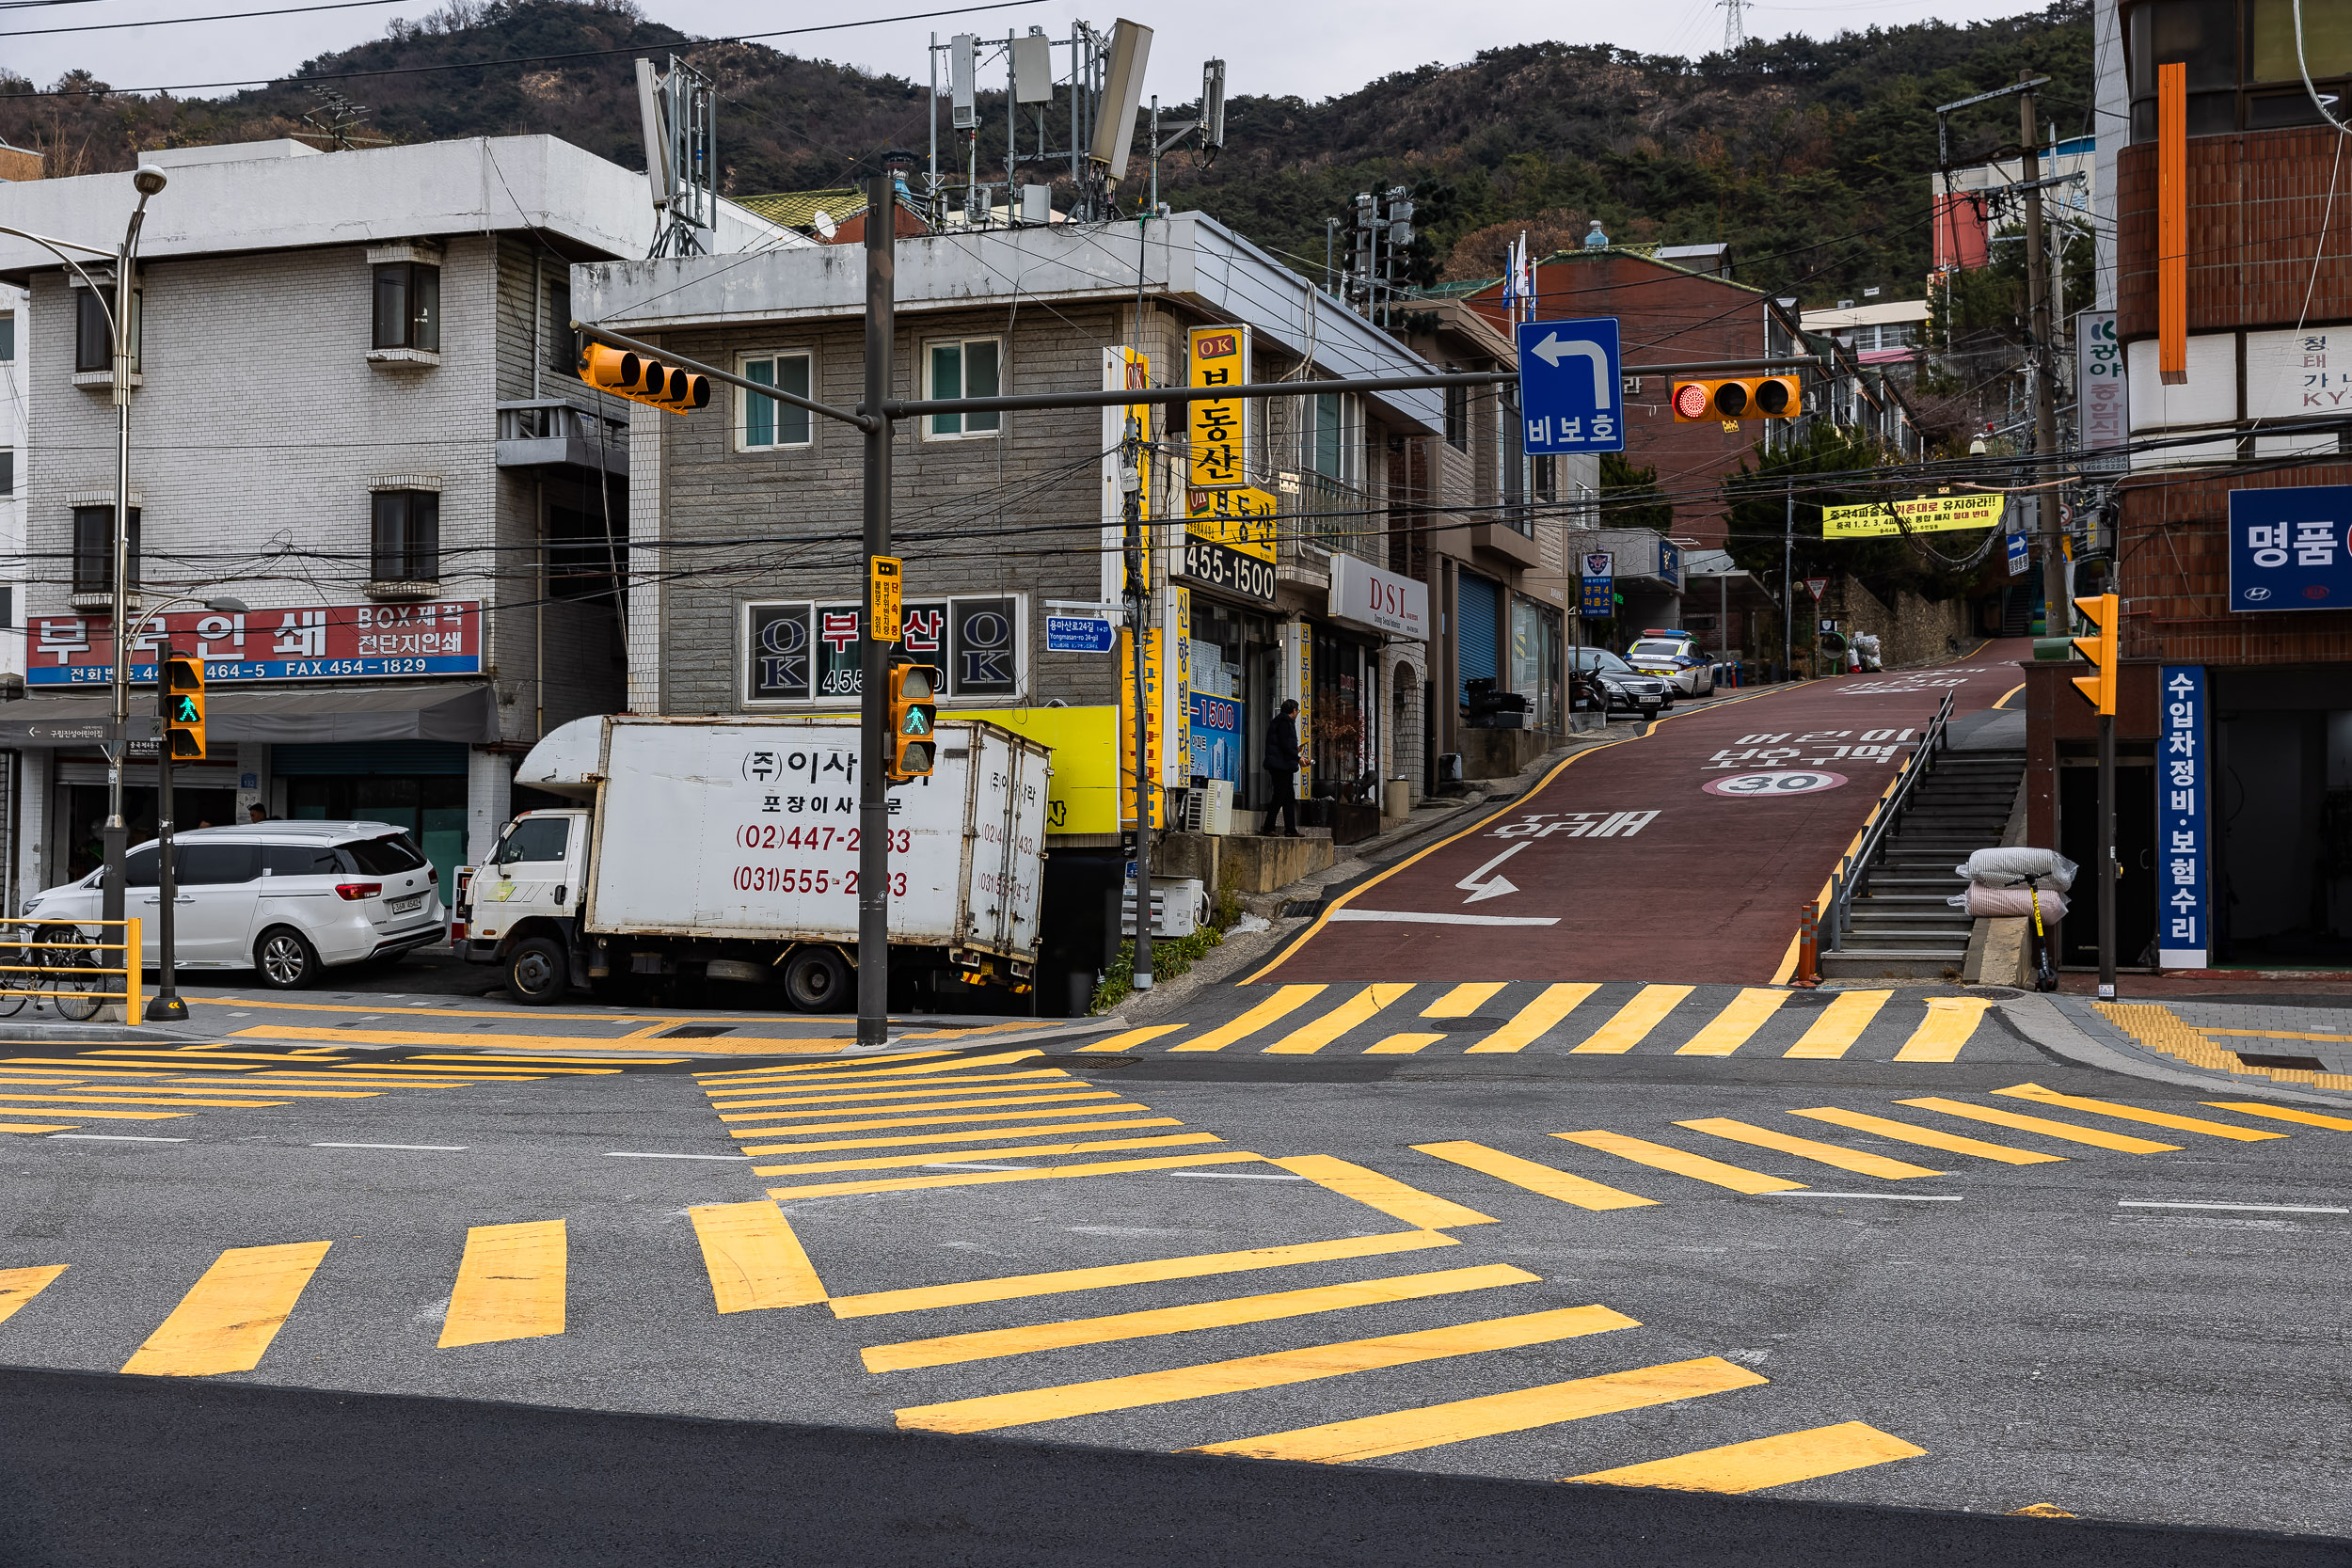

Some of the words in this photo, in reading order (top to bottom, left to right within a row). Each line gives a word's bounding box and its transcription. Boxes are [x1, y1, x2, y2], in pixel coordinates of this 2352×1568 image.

[1200, 338, 1231, 355] OK
[1197, 368, 1239, 480] 부동산
[1528, 414, 1617, 446] 비보호
[1895, 502, 1938, 515] 기존대로
[1944, 497, 1995, 510] 유지하라!!
[2249, 521, 2338, 567] 명품
[1186, 541, 1274, 599] 455-1500
[1370, 577, 1405, 618] DSI
[38, 611, 326, 665] 부국인쇄
[822, 610, 943, 653] 부산
[1050, 620, 1094, 632] 용마산로24길
[358, 632, 463, 656] 전단지인쇄
[762, 618, 807, 689] OK
[962, 611, 1011, 684] OK
[286, 658, 426, 676] FAX.454-1829
[1301, 627, 1311, 798] 부동산컨설팅
[1734, 728, 1915, 745] 어린이
[1701, 745, 1899, 769] 보호구역
[1728, 775, 1819, 791] 30
[762, 796, 902, 816] 포장이사문
[737, 824, 911, 853] (02)447-23
[733, 866, 907, 896] (031)555-23
